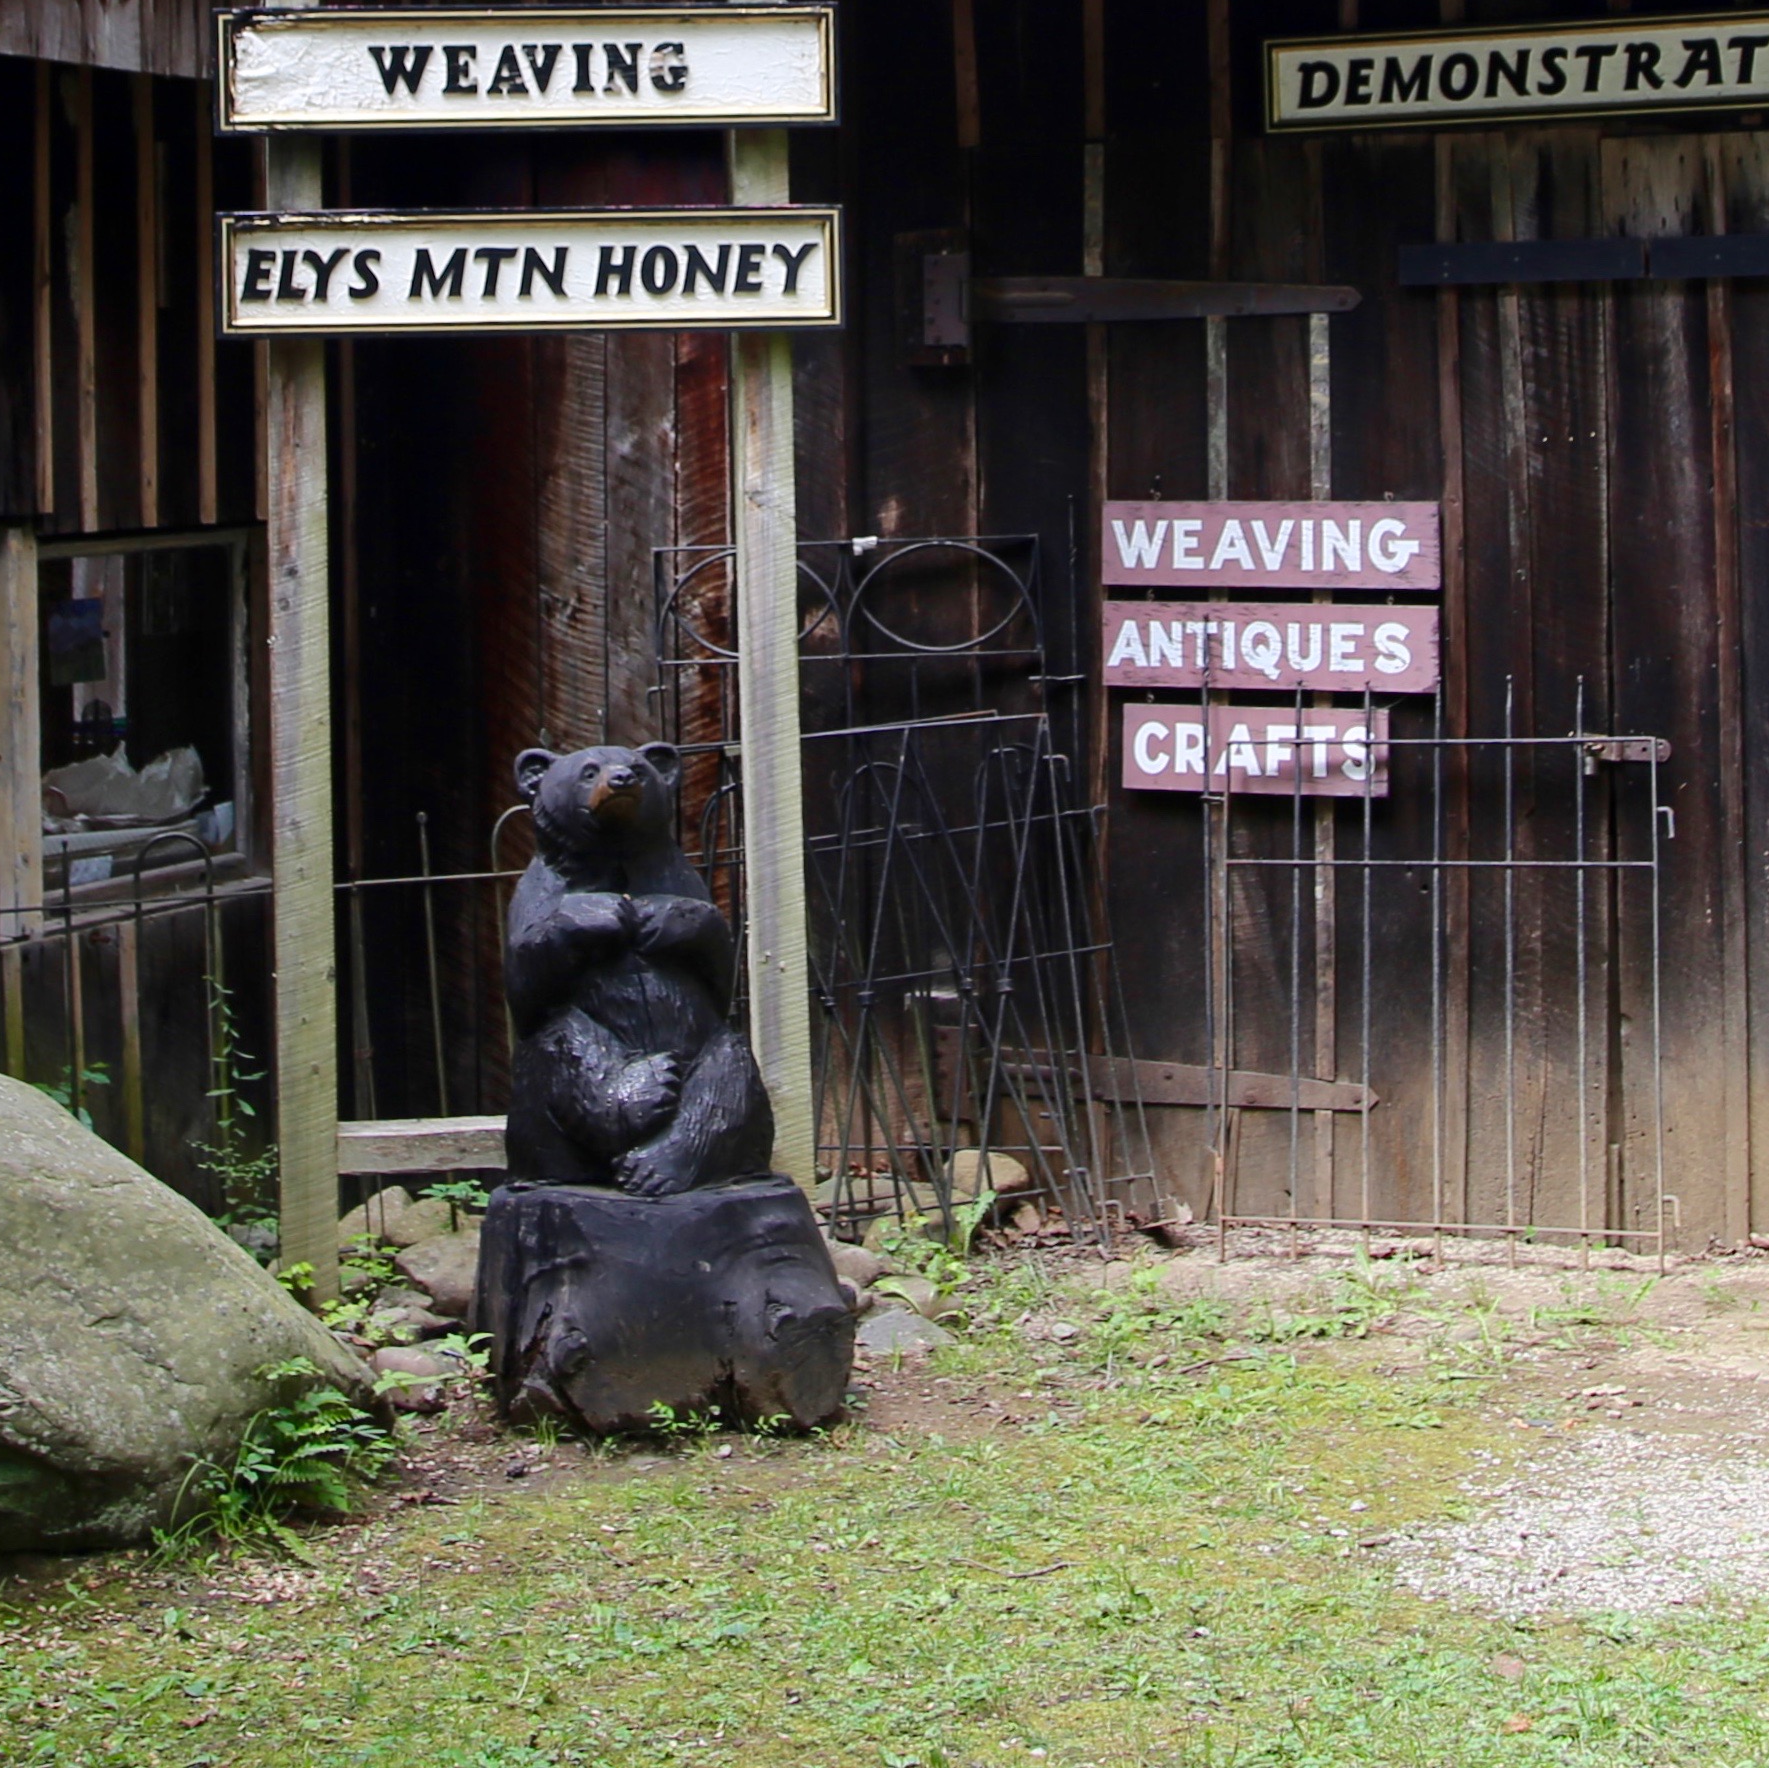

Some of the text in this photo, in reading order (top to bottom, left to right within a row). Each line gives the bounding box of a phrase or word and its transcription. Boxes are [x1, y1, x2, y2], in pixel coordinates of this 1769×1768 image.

[368, 42, 689, 96] WEAVING
[239, 243, 818, 302] ELYS MTN HONEY
[1111, 518, 1420, 574] WEAVING
[1107, 619, 1412, 680] ANTIQUES
[1133, 720, 1377, 782] CRAFTS
